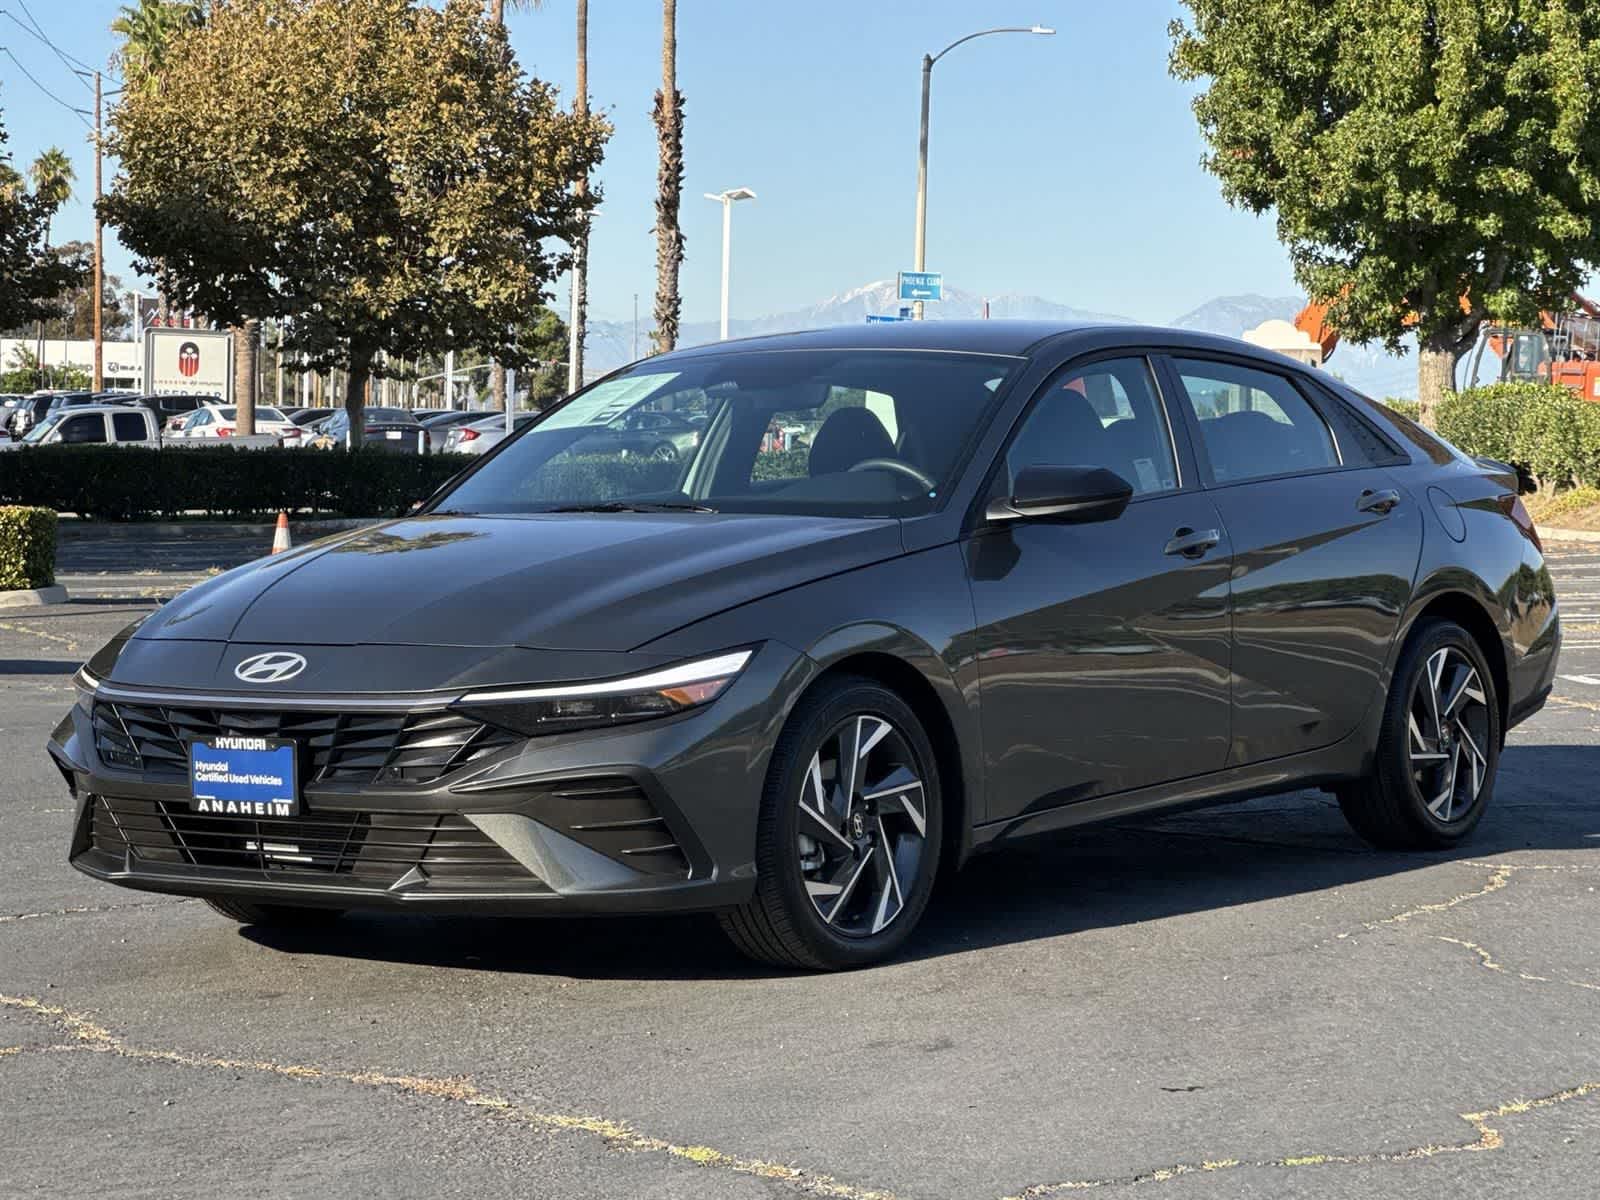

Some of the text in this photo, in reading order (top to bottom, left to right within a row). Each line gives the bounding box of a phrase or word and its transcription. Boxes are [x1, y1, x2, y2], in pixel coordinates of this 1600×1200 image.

[927, 277, 941, 286] CLUB
[215, 737, 267, 751] HYUNDAI
[195, 760, 229, 773] Hyundai
[195, 772, 283, 786] Certified Used Vehicles
[198, 799, 290, 817] ANAHEIM
